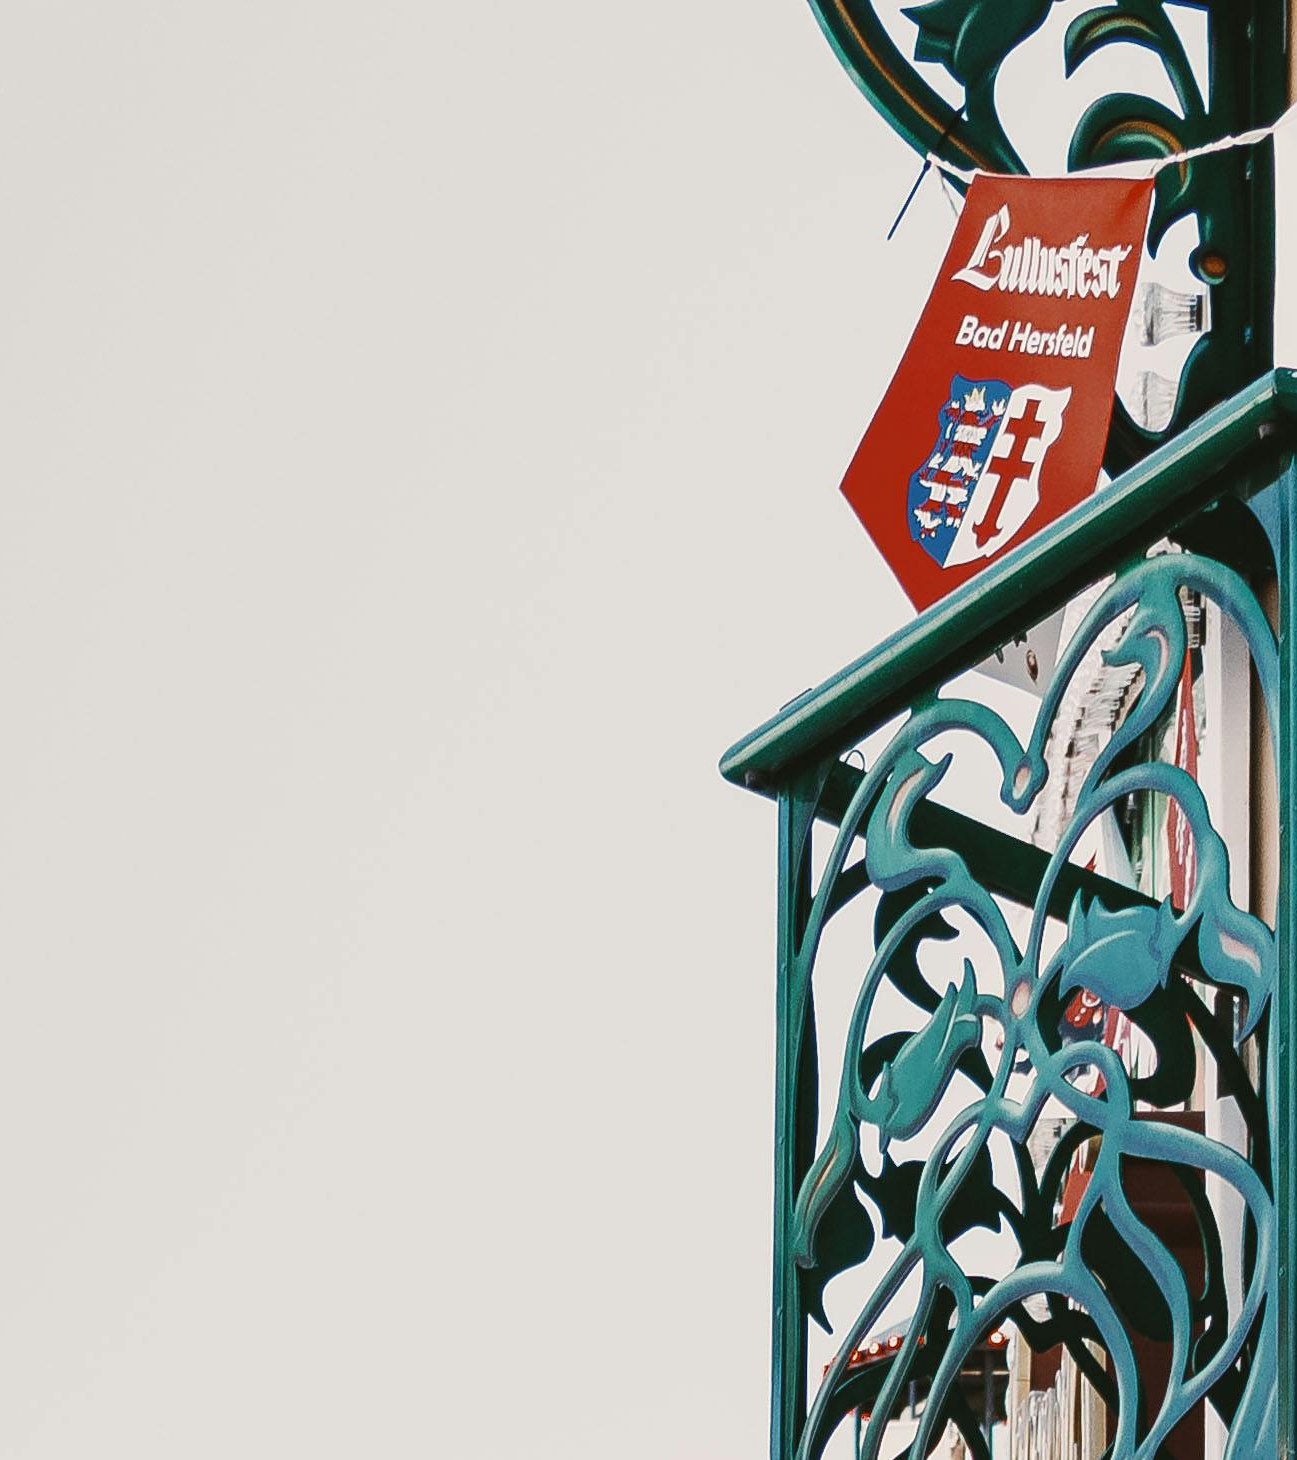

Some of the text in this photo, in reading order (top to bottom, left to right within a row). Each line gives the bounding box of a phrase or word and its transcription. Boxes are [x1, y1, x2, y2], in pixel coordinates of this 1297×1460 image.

[951, 203, 1133, 299] Lullusfest
[955, 314, 1095, 359] Bad Hersfeld
